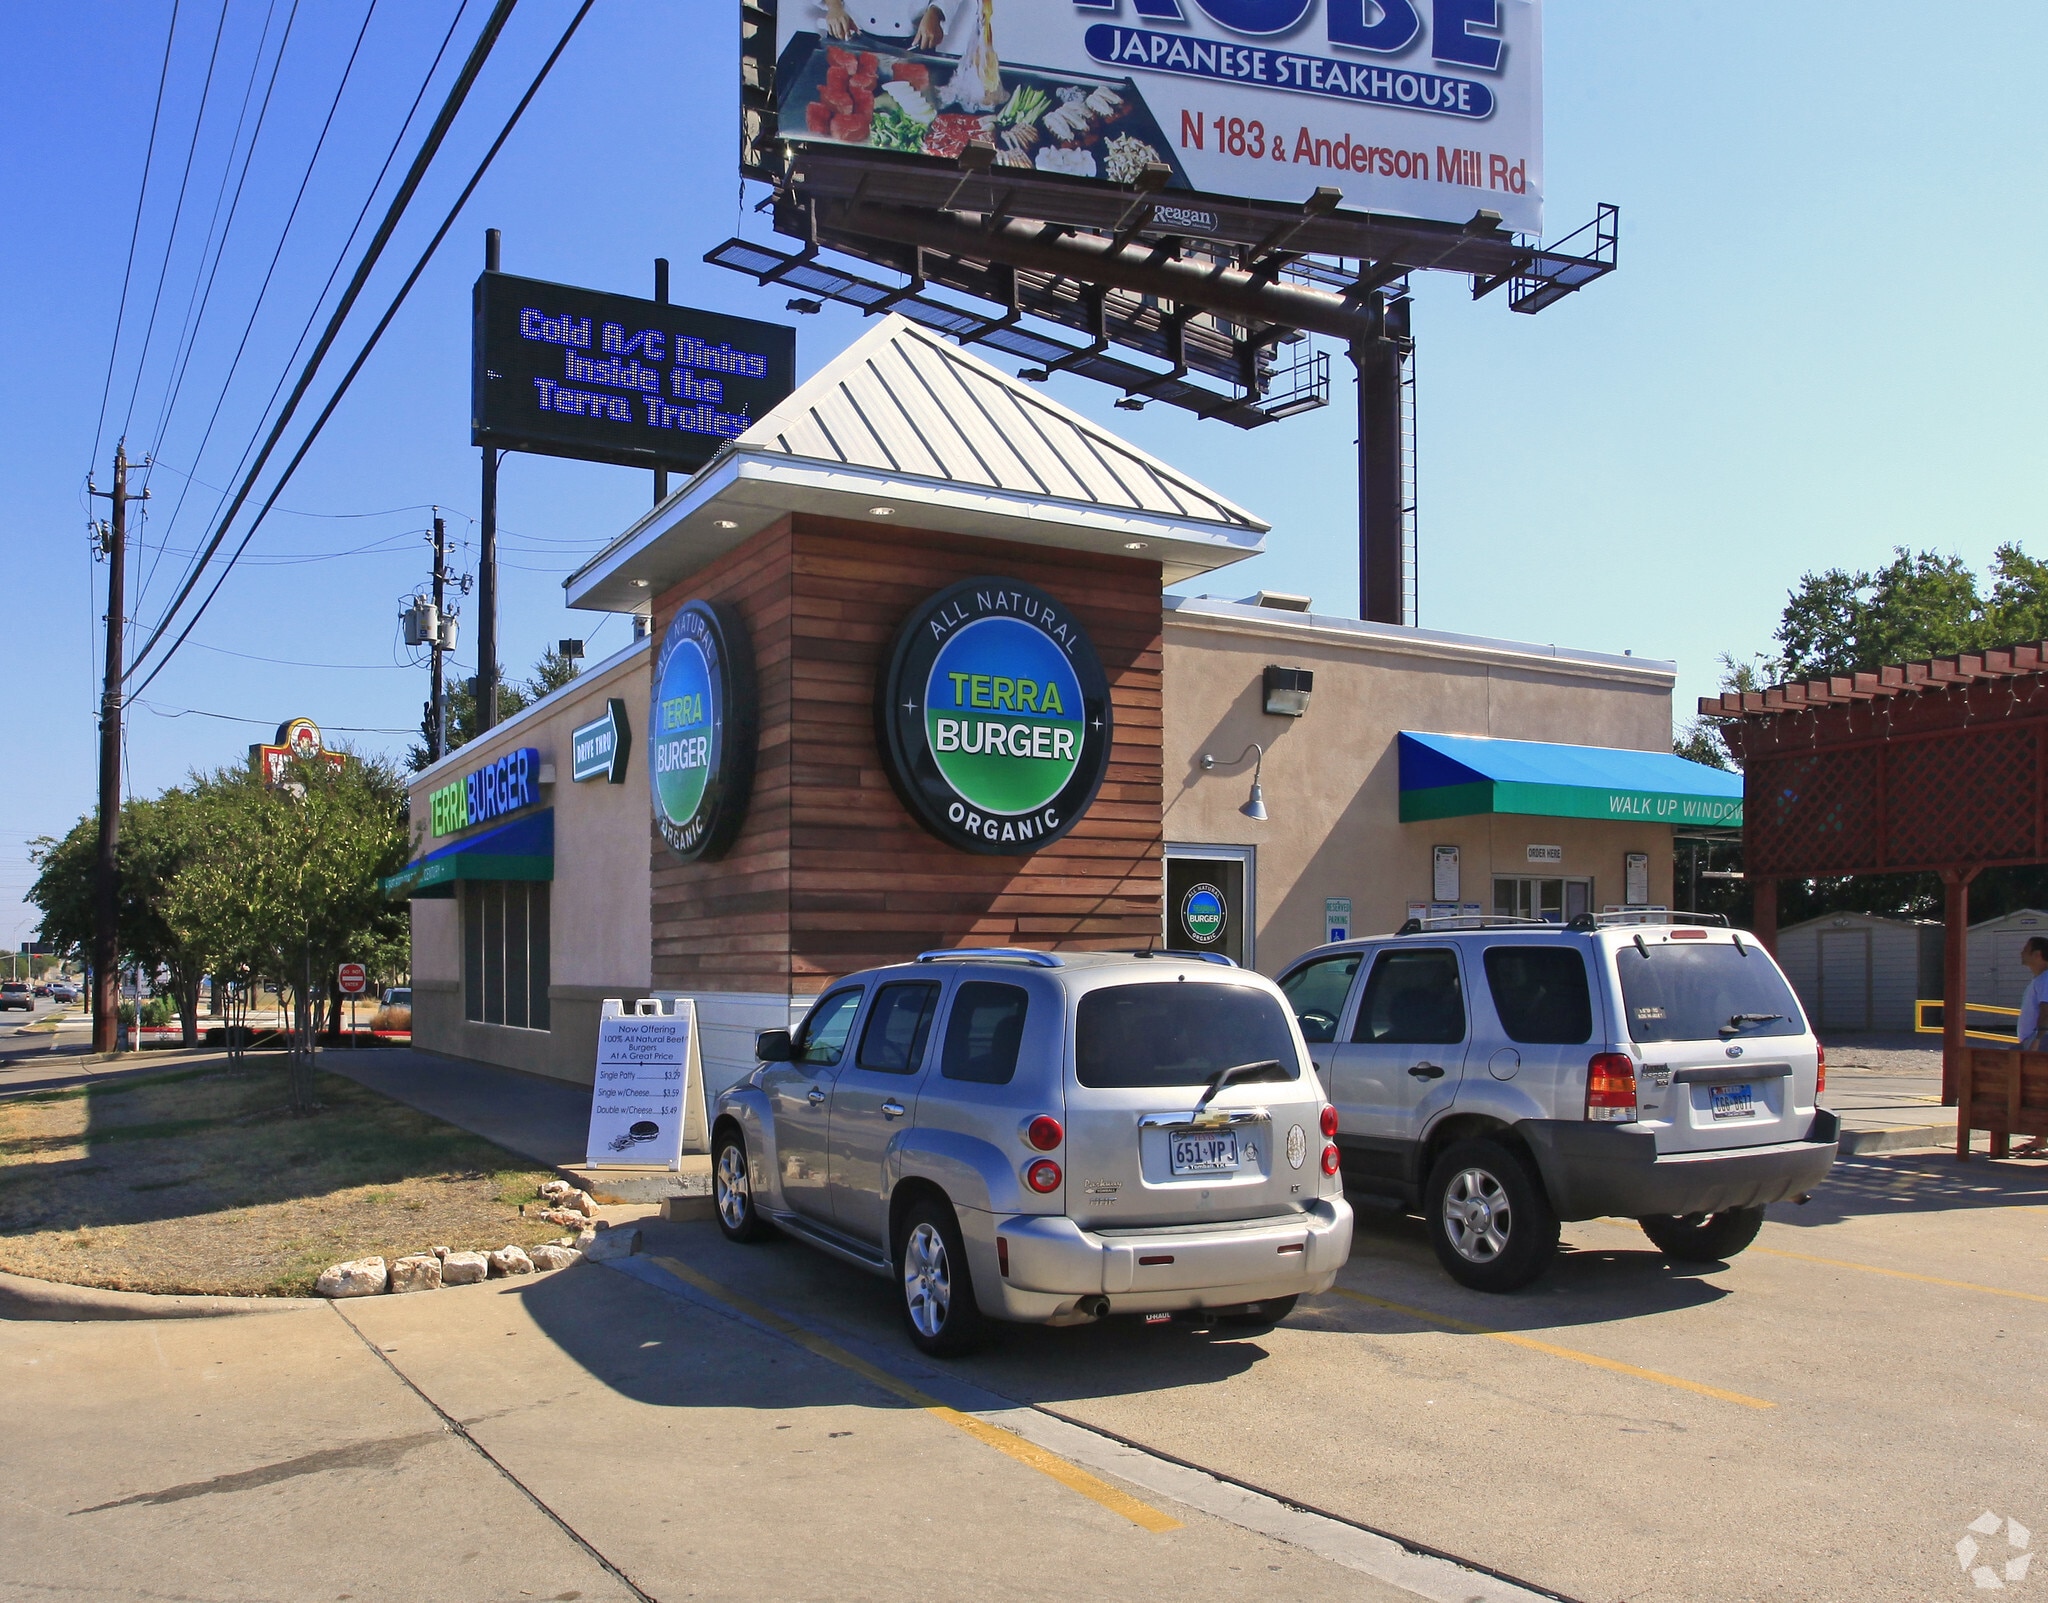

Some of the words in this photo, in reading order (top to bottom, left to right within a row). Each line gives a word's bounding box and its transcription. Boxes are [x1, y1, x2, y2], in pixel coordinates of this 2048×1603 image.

[1110, 30, 1267, 80] JAPANESE
[1275, 56, 1471, 111] STEAKHOUSE
[1181, 109, 1204, 150] N
[1213, 114, 1266, 160] 183
[1271, 135, 1286, 161] &
[1293, 127, 1429, 181] Anderson
[1437, 146, 1482, 188] Mill
[1489, 154, 1527, 195] Rd
[1153, 205, 1211, 226] Reagan
[520, 307, 593, 349] Cold
[602, 321, 666, 362] A/C
[674, 333, 768, 379] Dining
[565, 348, 660, 394] Inside
[669, 366, 723, 404] the
[533, 377, 632, 423] Terra
[930, 601, 969, 641] ALL
[976, 590, 1079, 655] NATURAL
[674, 613, 714, 660] NATURAL
[948, 671, 1065, 715] TERRA
[662, 692, 703, 731] TERRA
[577, 739, 594, 764] DRIVE
[595, 731, 612, 756] THRU
[936, 717, 1076, 761] BURGER
[657, 735, 708, 773] BURGER
[1609, 795, 1652, 815] WALK
[1657, 799, 1678, 816] UP
[948, 802, 1060, 842] ORGANIC
[660, 815, 703, 851] ORGANIC
[1528, 848, 1545, 858] ORDER
[1547, 848, 1561, 859] HERE
[1188, 889, 1198, 899] ALL
[1197, 885, 1220, 899] NATURAL
[1190, 915, 1219, 923] BURGER
[1328, 915, 1348, 924] PARKING
[1192, 932, 1217, 941] ORGANIC
[604, 1035, 623, 1043] 100%
[624, 1035, 635, 1043] All
[636, 1035, 665, 1043] Natural
[666, 1035, 684, 1044] Beef
[618, 1025, 639, 1034] Now
[640, 1025, 676, 1035] Offering
[610, 1052, 619, 1060] At
[628, 1043, 657, 1052] Burgers
[600, 1071, 618, 1081] Single
[619, 1070, 635, 1080] Patty
[598, 1088, 616, 1099] Single
[617, 1088, 650, 1097] w/Cheese
[663, 1088, 680, 1098] $3.59
[596, 1105, 620, 1114] Double
[620, 1105, 653, 1115] w/Cheese
[661, 1106, 678, 1115] $5.49
[1145, 1312, 1171, 1321] U-HAUL
